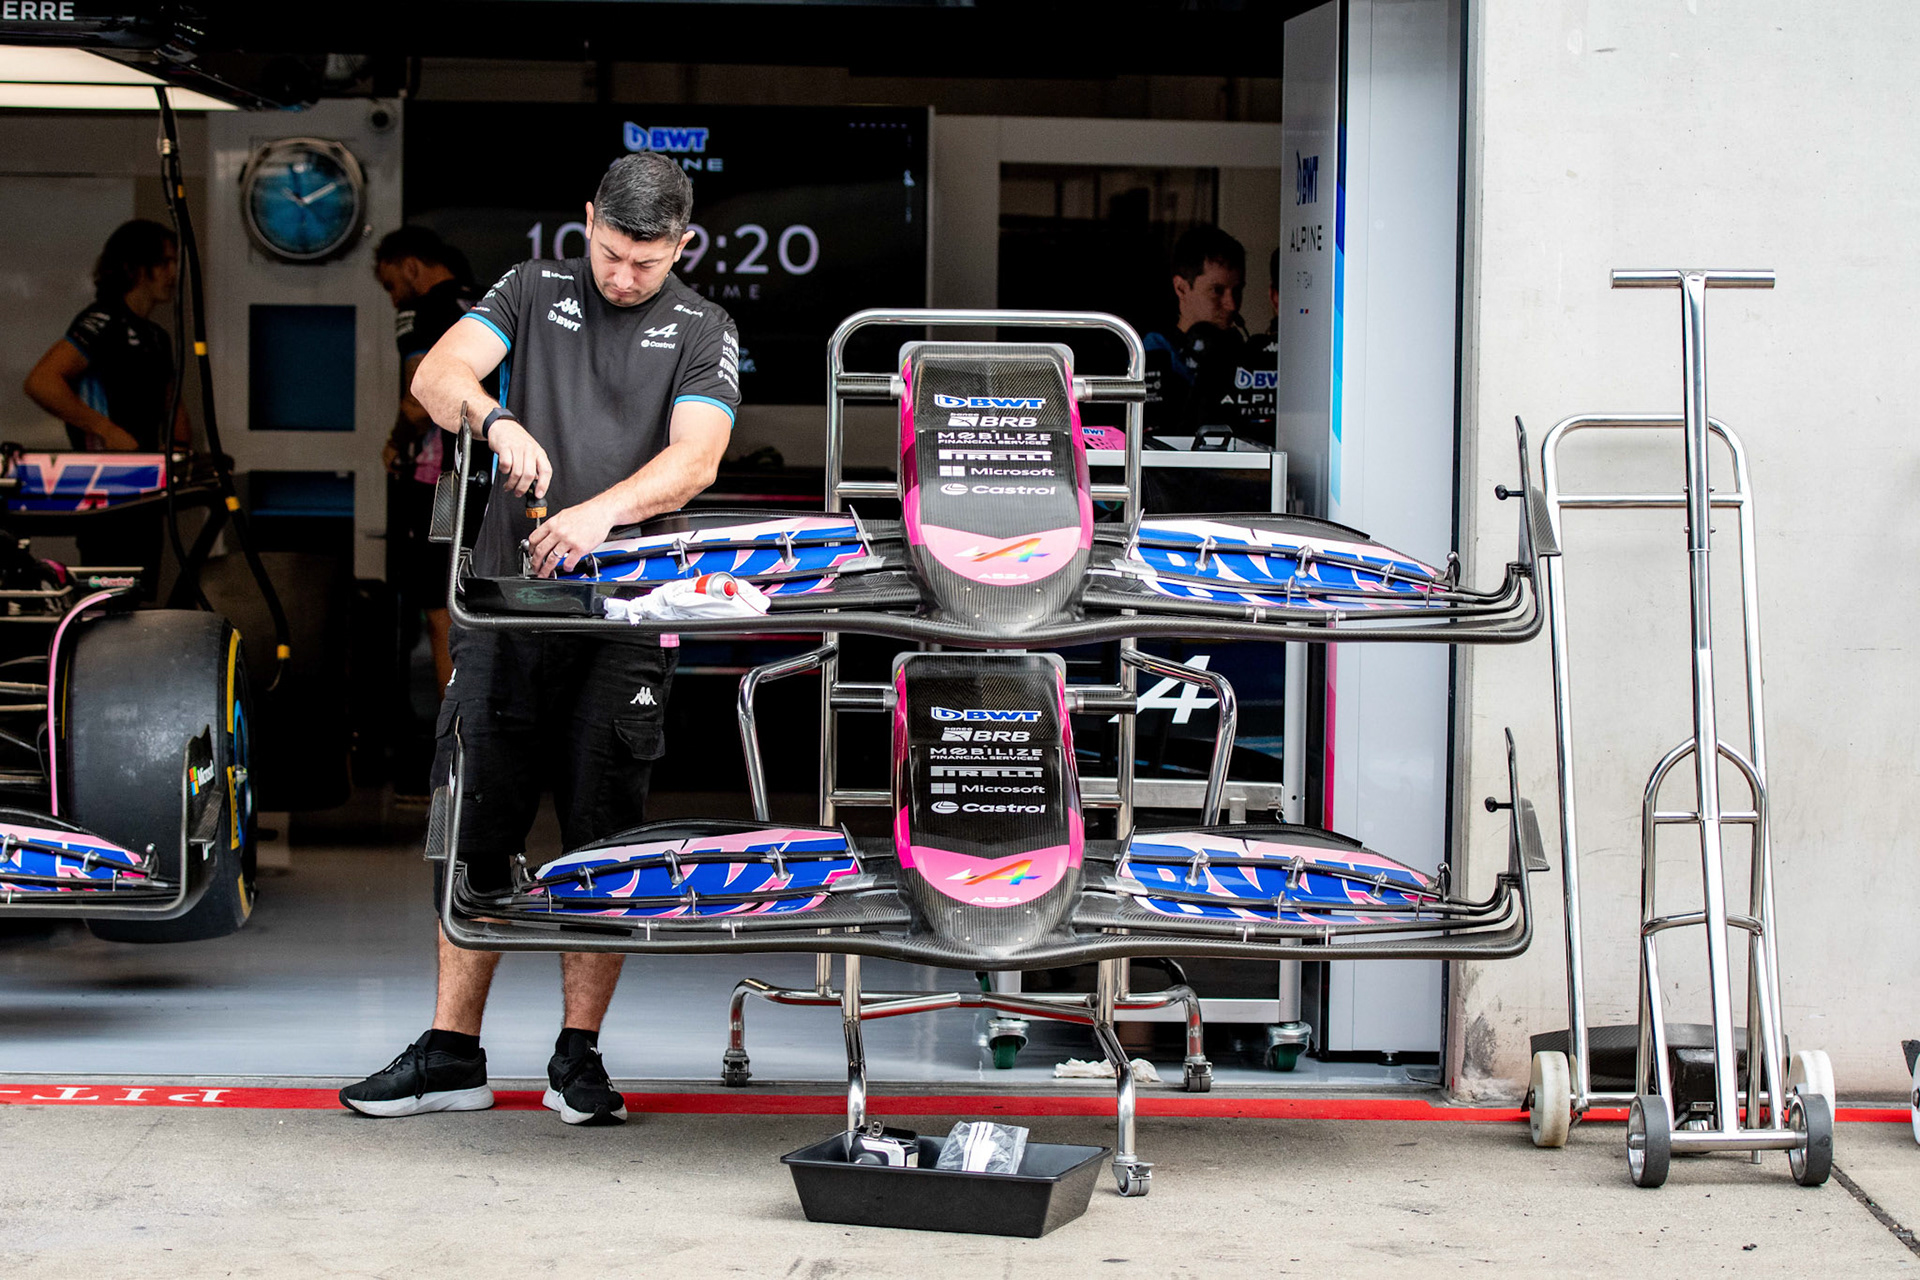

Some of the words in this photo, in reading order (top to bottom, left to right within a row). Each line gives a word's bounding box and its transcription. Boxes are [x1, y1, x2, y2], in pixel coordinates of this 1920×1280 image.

[648, 126, 709, 152] BWT
[1290, 225, 1322, 252] ALPINE
[555, 314, 581, 332] BWT
[650, 341, 676, 349] Castrol
[967, 396, 1046, 409] BWT
[1221, 394, 1274, 404] ALPI
[1259, 407, 1276, 416] TEA
[979, 416, 1038, 428] BRB
[938, 449, 1053, 461] PIRELLI
[970, 467, 1056, 477] Microsoft
[971, 485, 1057, 495] Castrol
[964, 709, 1042, 722] BWT
[972, 730, 1031, 742] BRB
[930, 766, 1044, 778] PIRELLI
[961, 784, 1046, 794] Microsoft
[962, 803, 1047, 813] Castrol
